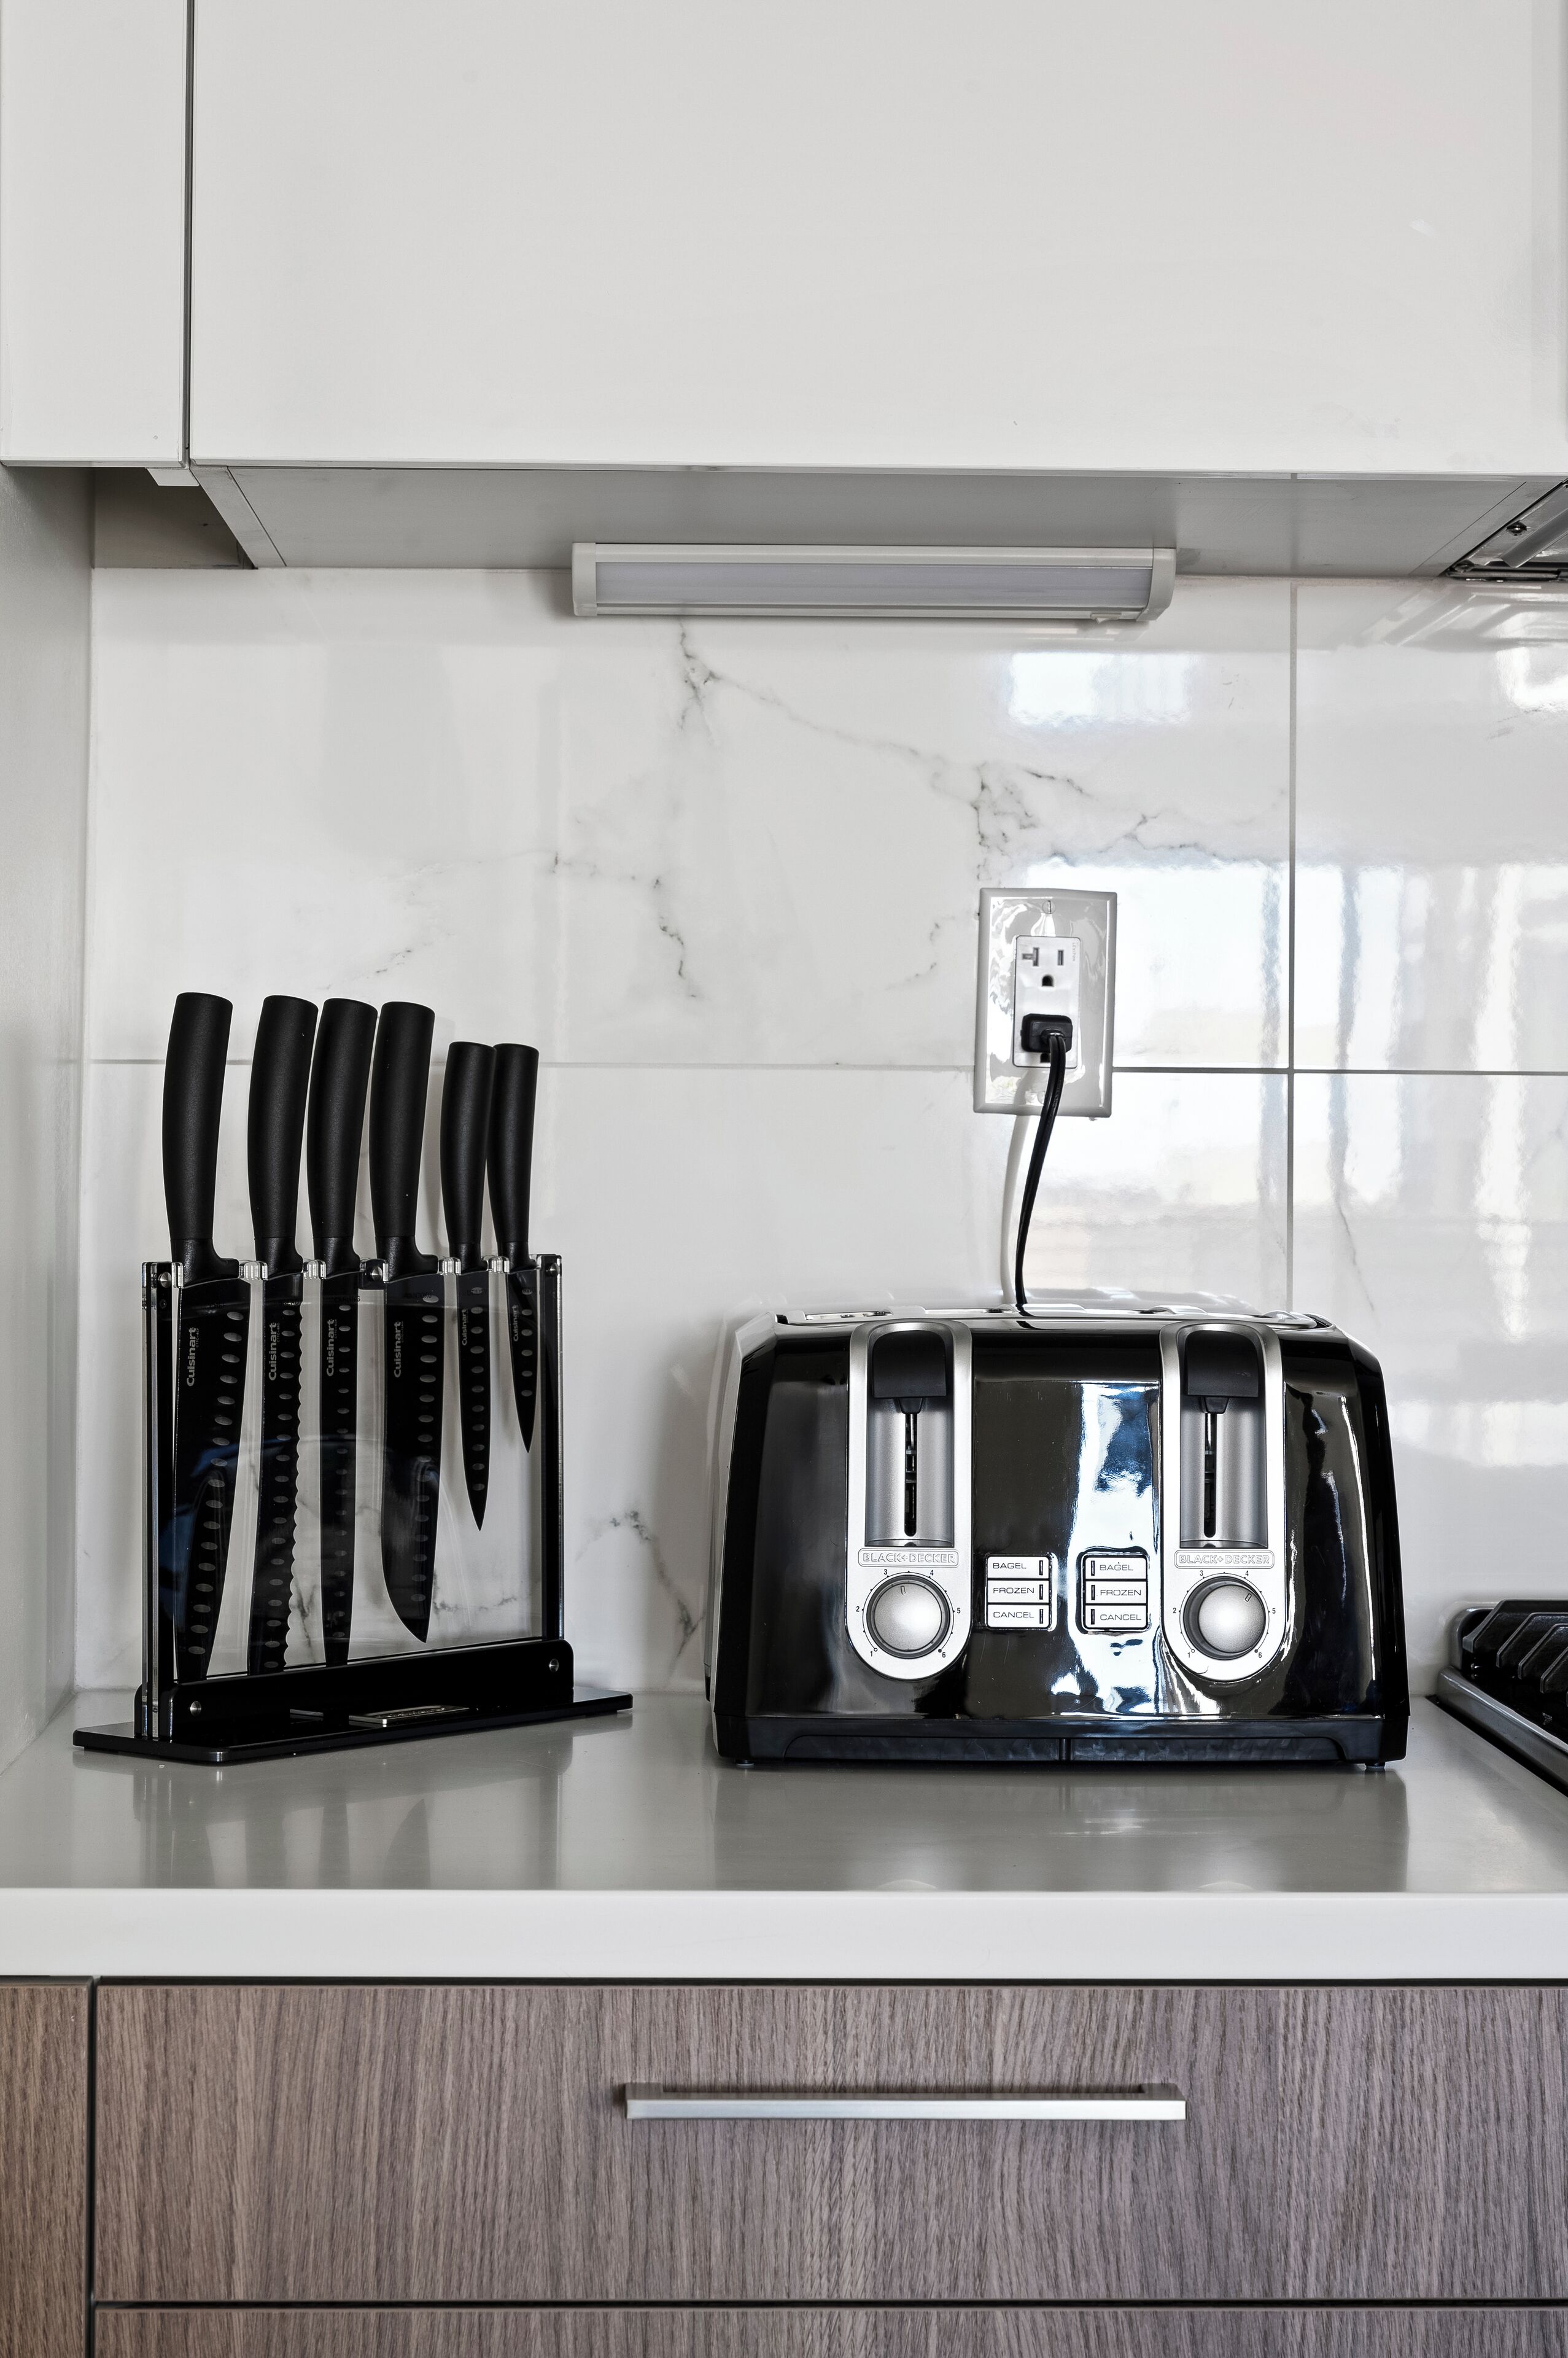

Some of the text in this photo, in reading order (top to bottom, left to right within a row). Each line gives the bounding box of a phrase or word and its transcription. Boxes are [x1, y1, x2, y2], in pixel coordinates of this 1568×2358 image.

[186, 1327, 196, 1387] Cuisinart
[268, 1322, 278, 1381] Cuisinart
[327, 1319, 335, 1377] Cuisinart
[394, 1321, 402, 1379] Cuisinart
[863, 1553, 955, 1563] BLACK+DECKER
[1179, 1555, 1270, 1564] BLACK+DECKER
